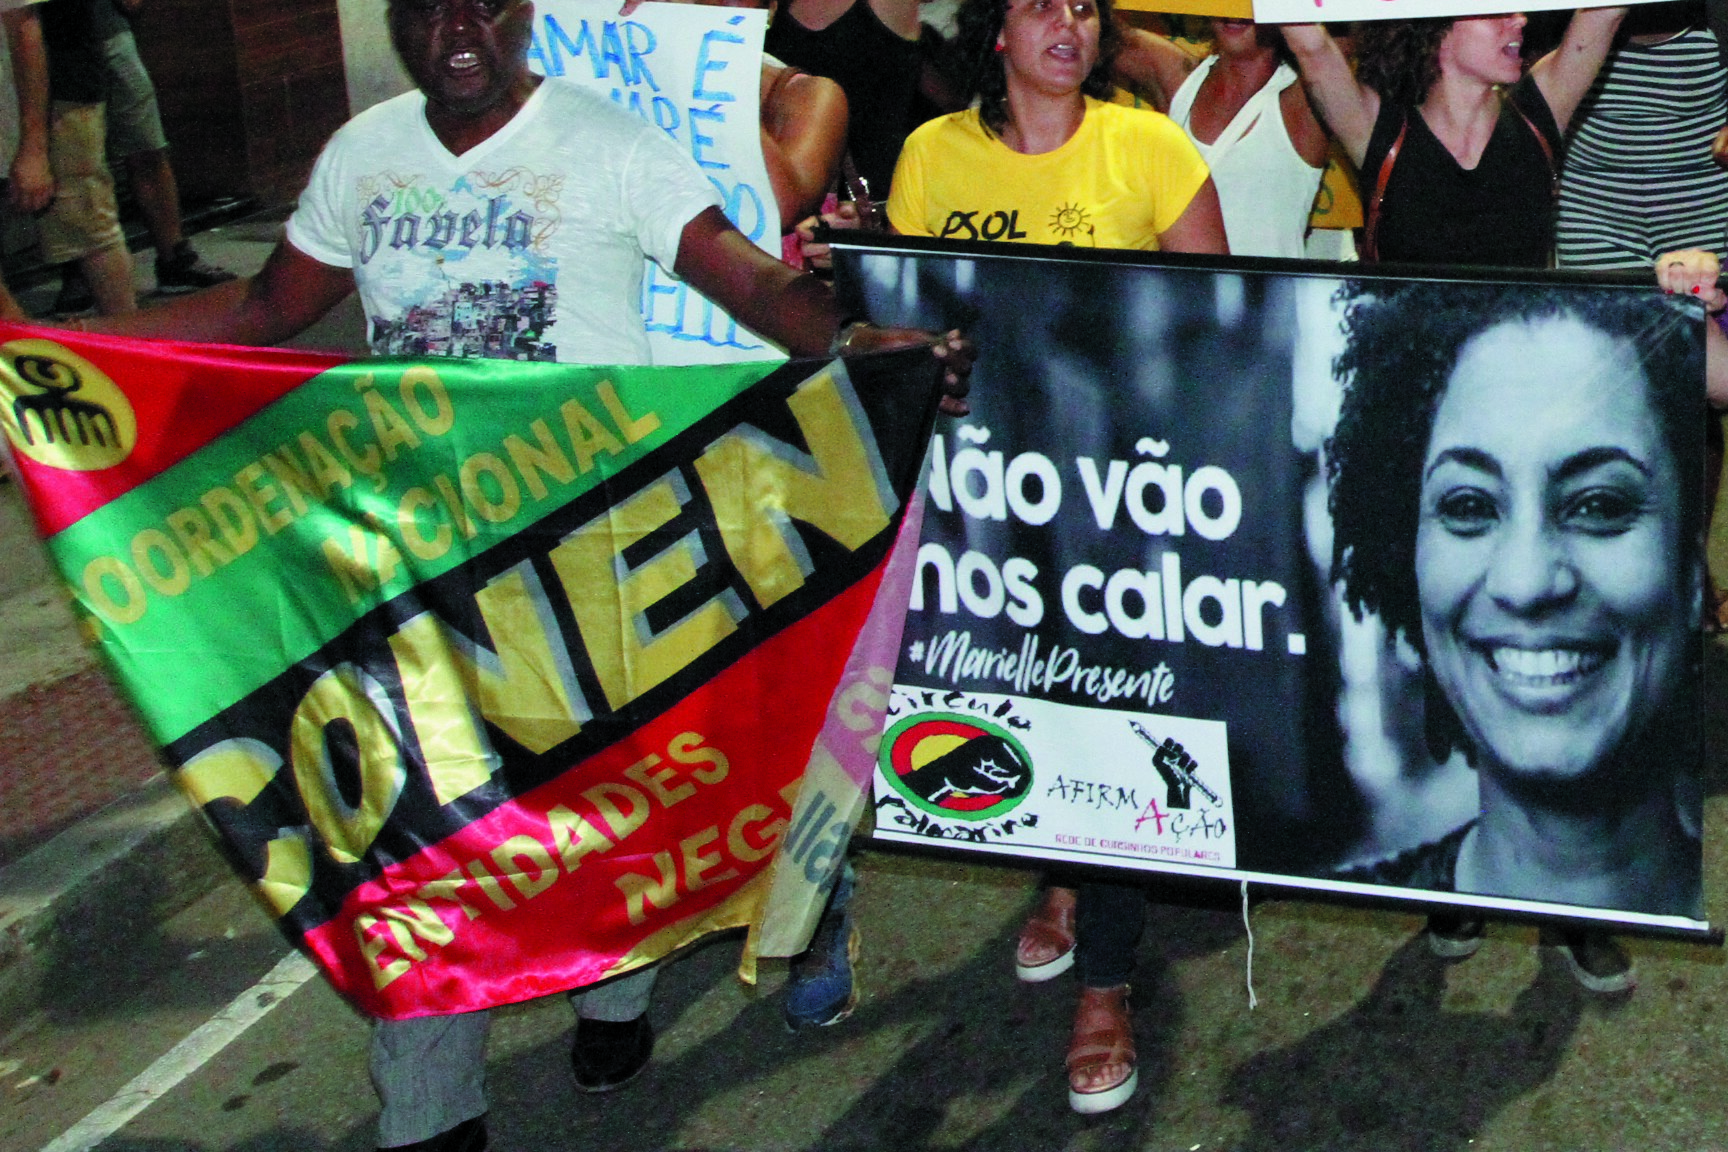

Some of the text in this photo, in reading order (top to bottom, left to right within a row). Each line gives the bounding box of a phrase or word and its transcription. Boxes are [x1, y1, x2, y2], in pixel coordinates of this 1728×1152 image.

[692, 15, 747, 102] É
[940, 210, 1027, 241] PSOL
[320, 379, 662, 605] NACIONAL
[1076, 436, 1242, 541] vão
[909, 542, 1306, 655] nos calar.
[909, 629, 1174, 706] #MariellePresente
[352, 731, 730, 992] ENTIDADES
[614, 776, 803, 926] NEG
[1055, 833, 1081, 846] REDE
[1084, 837, 1097, 848] DE
